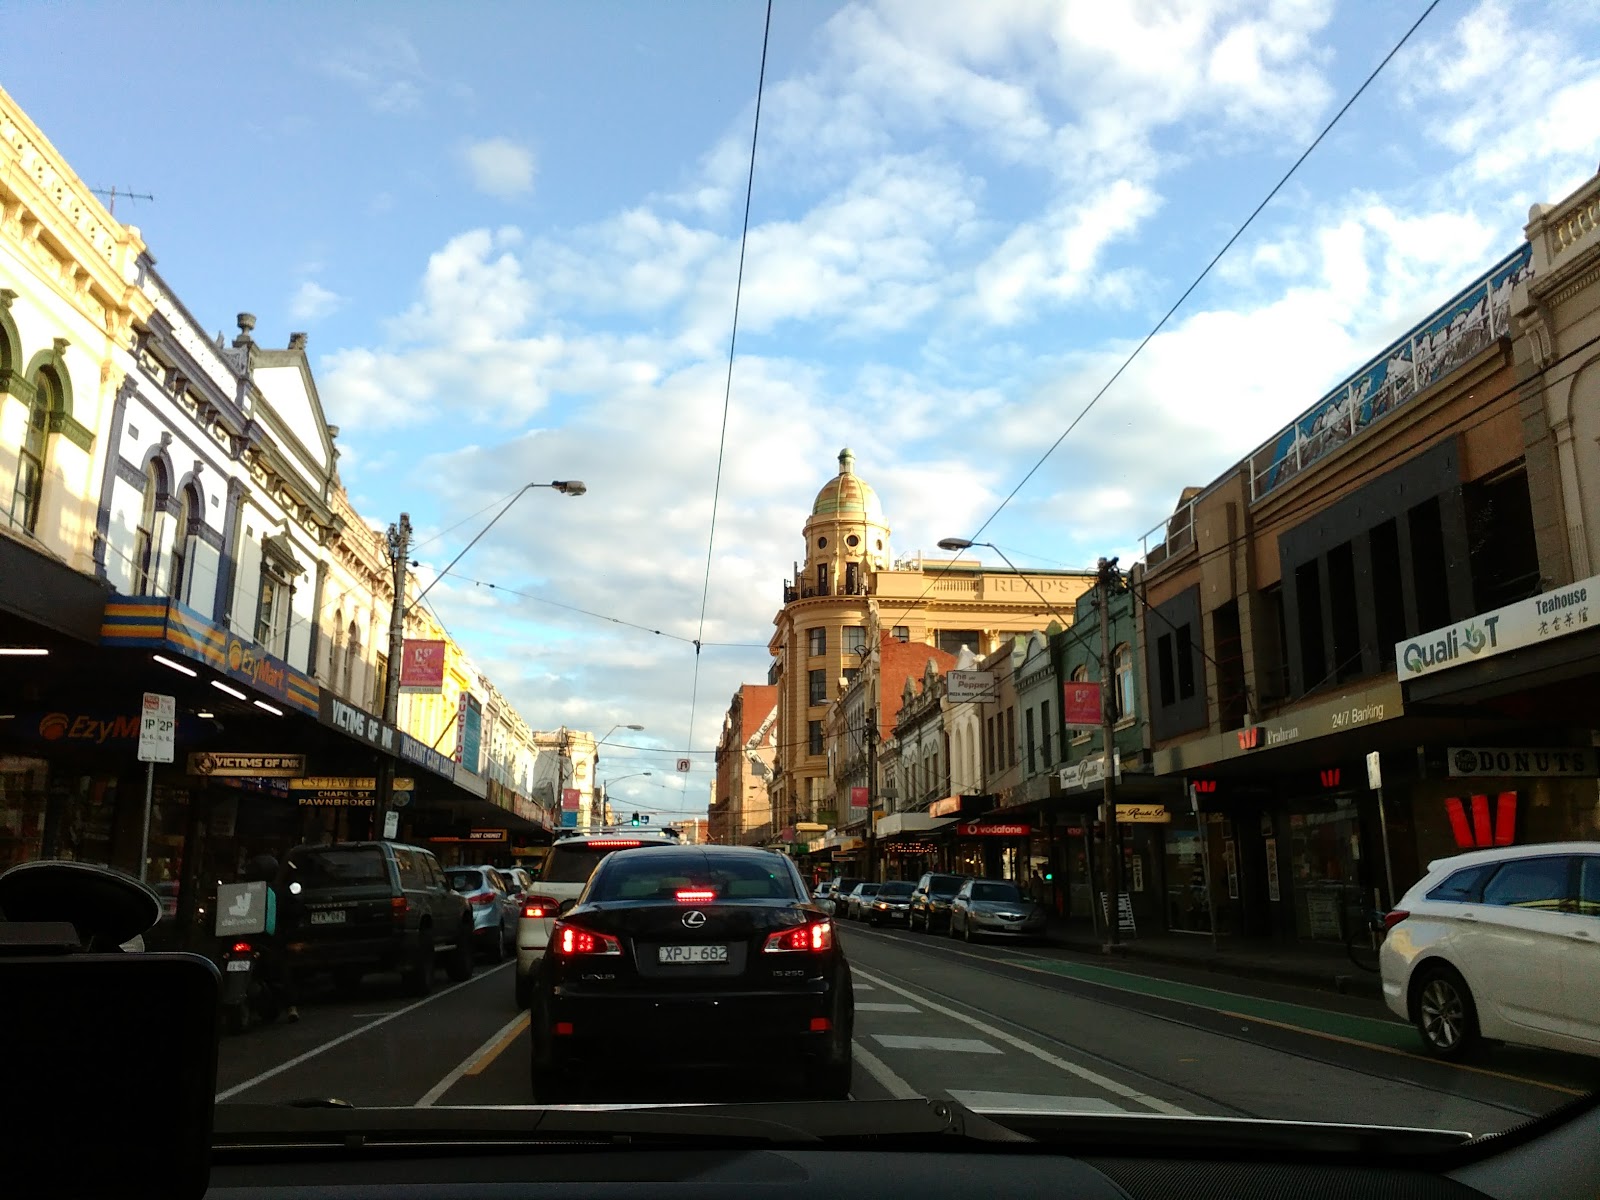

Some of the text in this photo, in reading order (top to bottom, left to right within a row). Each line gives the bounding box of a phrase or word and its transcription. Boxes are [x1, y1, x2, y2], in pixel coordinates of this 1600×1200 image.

[994, 579, 1068, 593] READ'S
[1535, 588, 1587, 615] Teahouse
[242, 648, 284, 690] EzyMart
[951, 672, 967, 680] The
[958, 681, 989, 690] Pepper
[332, 699, 365, 737] VICTIMS
[368, 719, 379, 742] OF
[1331, 704, 1384, 728] 24/7 Banking
[145, 719, 155, 730] 1P
[159, 721, 173, 732] 2P
[455, 694, 467, 764] AUCTION
[1267, 727, 1299, 745] Prahran
[215, 757, 300, 769] VICTIMS OF INK
[1478, 752, 1585, 772] DONUTS
[325, 778, 377, 788] JEWELLE
[980, 825, 1022, 834] vodafone
